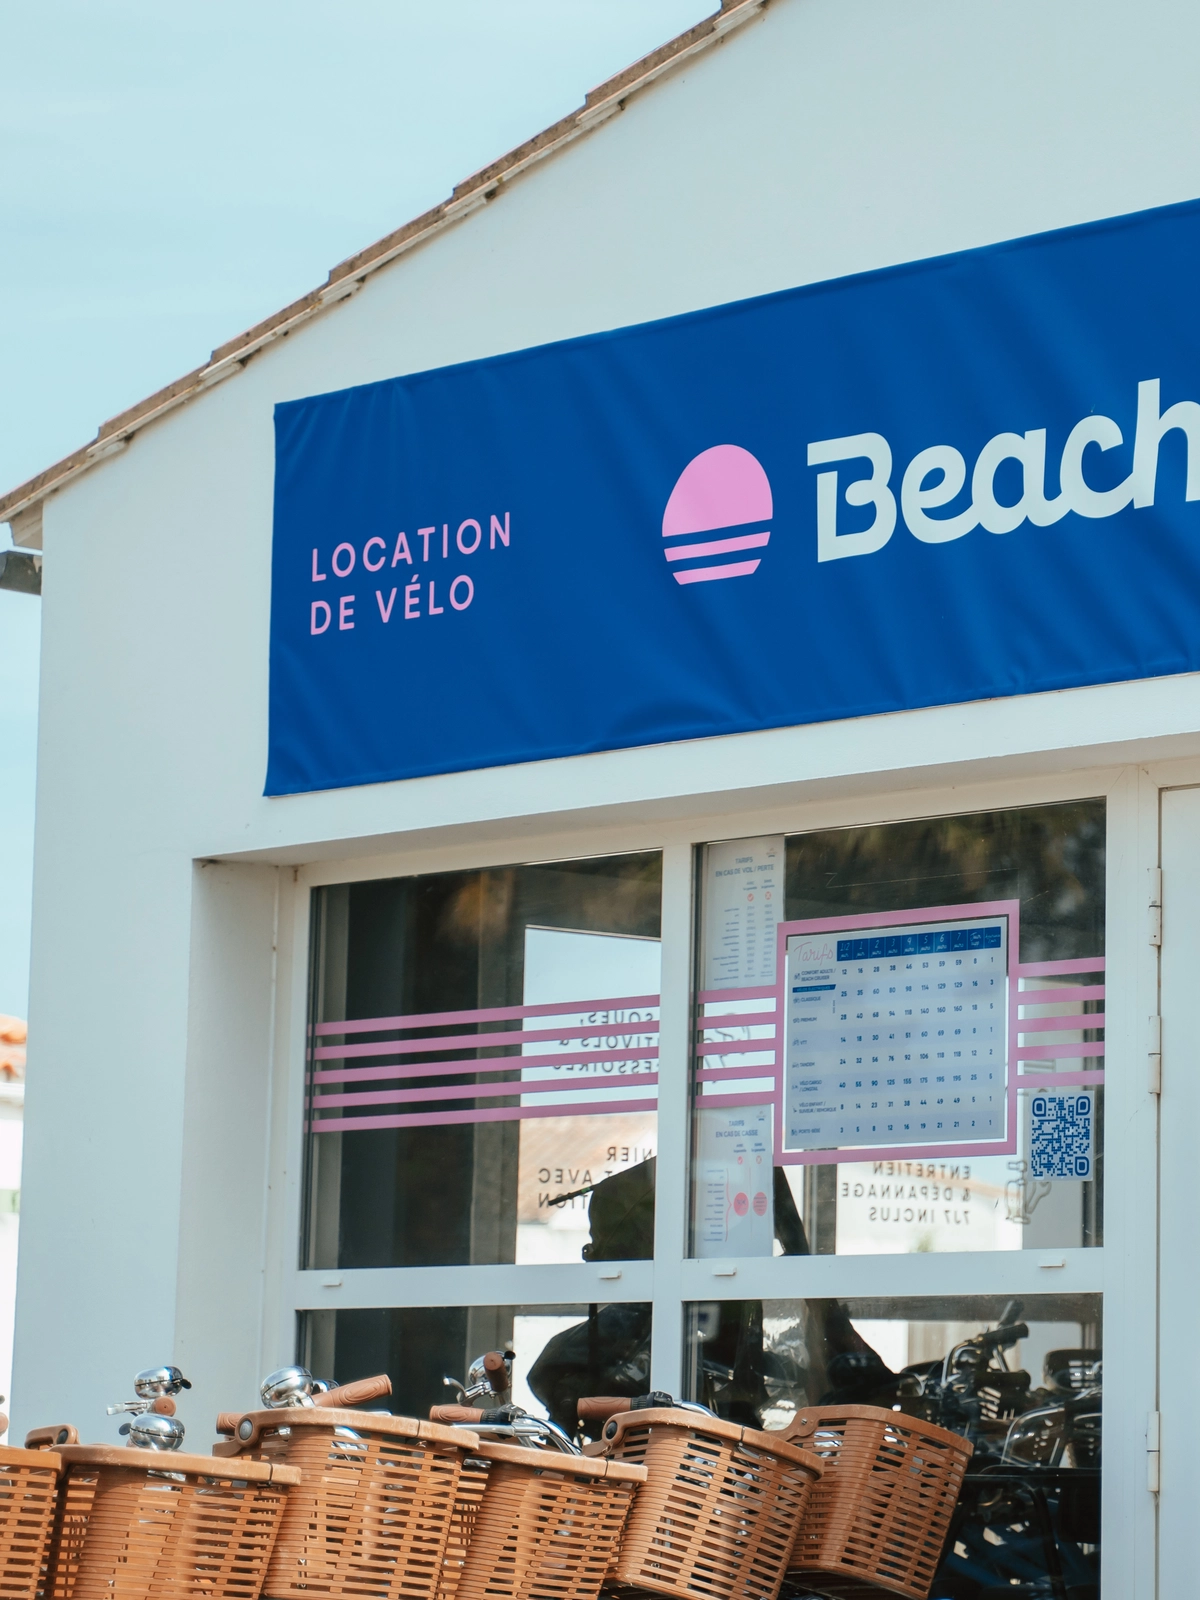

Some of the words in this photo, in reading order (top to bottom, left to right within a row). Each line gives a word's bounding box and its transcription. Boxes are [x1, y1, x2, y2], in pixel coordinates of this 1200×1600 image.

[312, 512, 510, 582] LOCATION
[311, 595, 355, 635] DE
[376, 574, 474, 623] VÉLO
[793, 941, 834, 966] Tarifs
